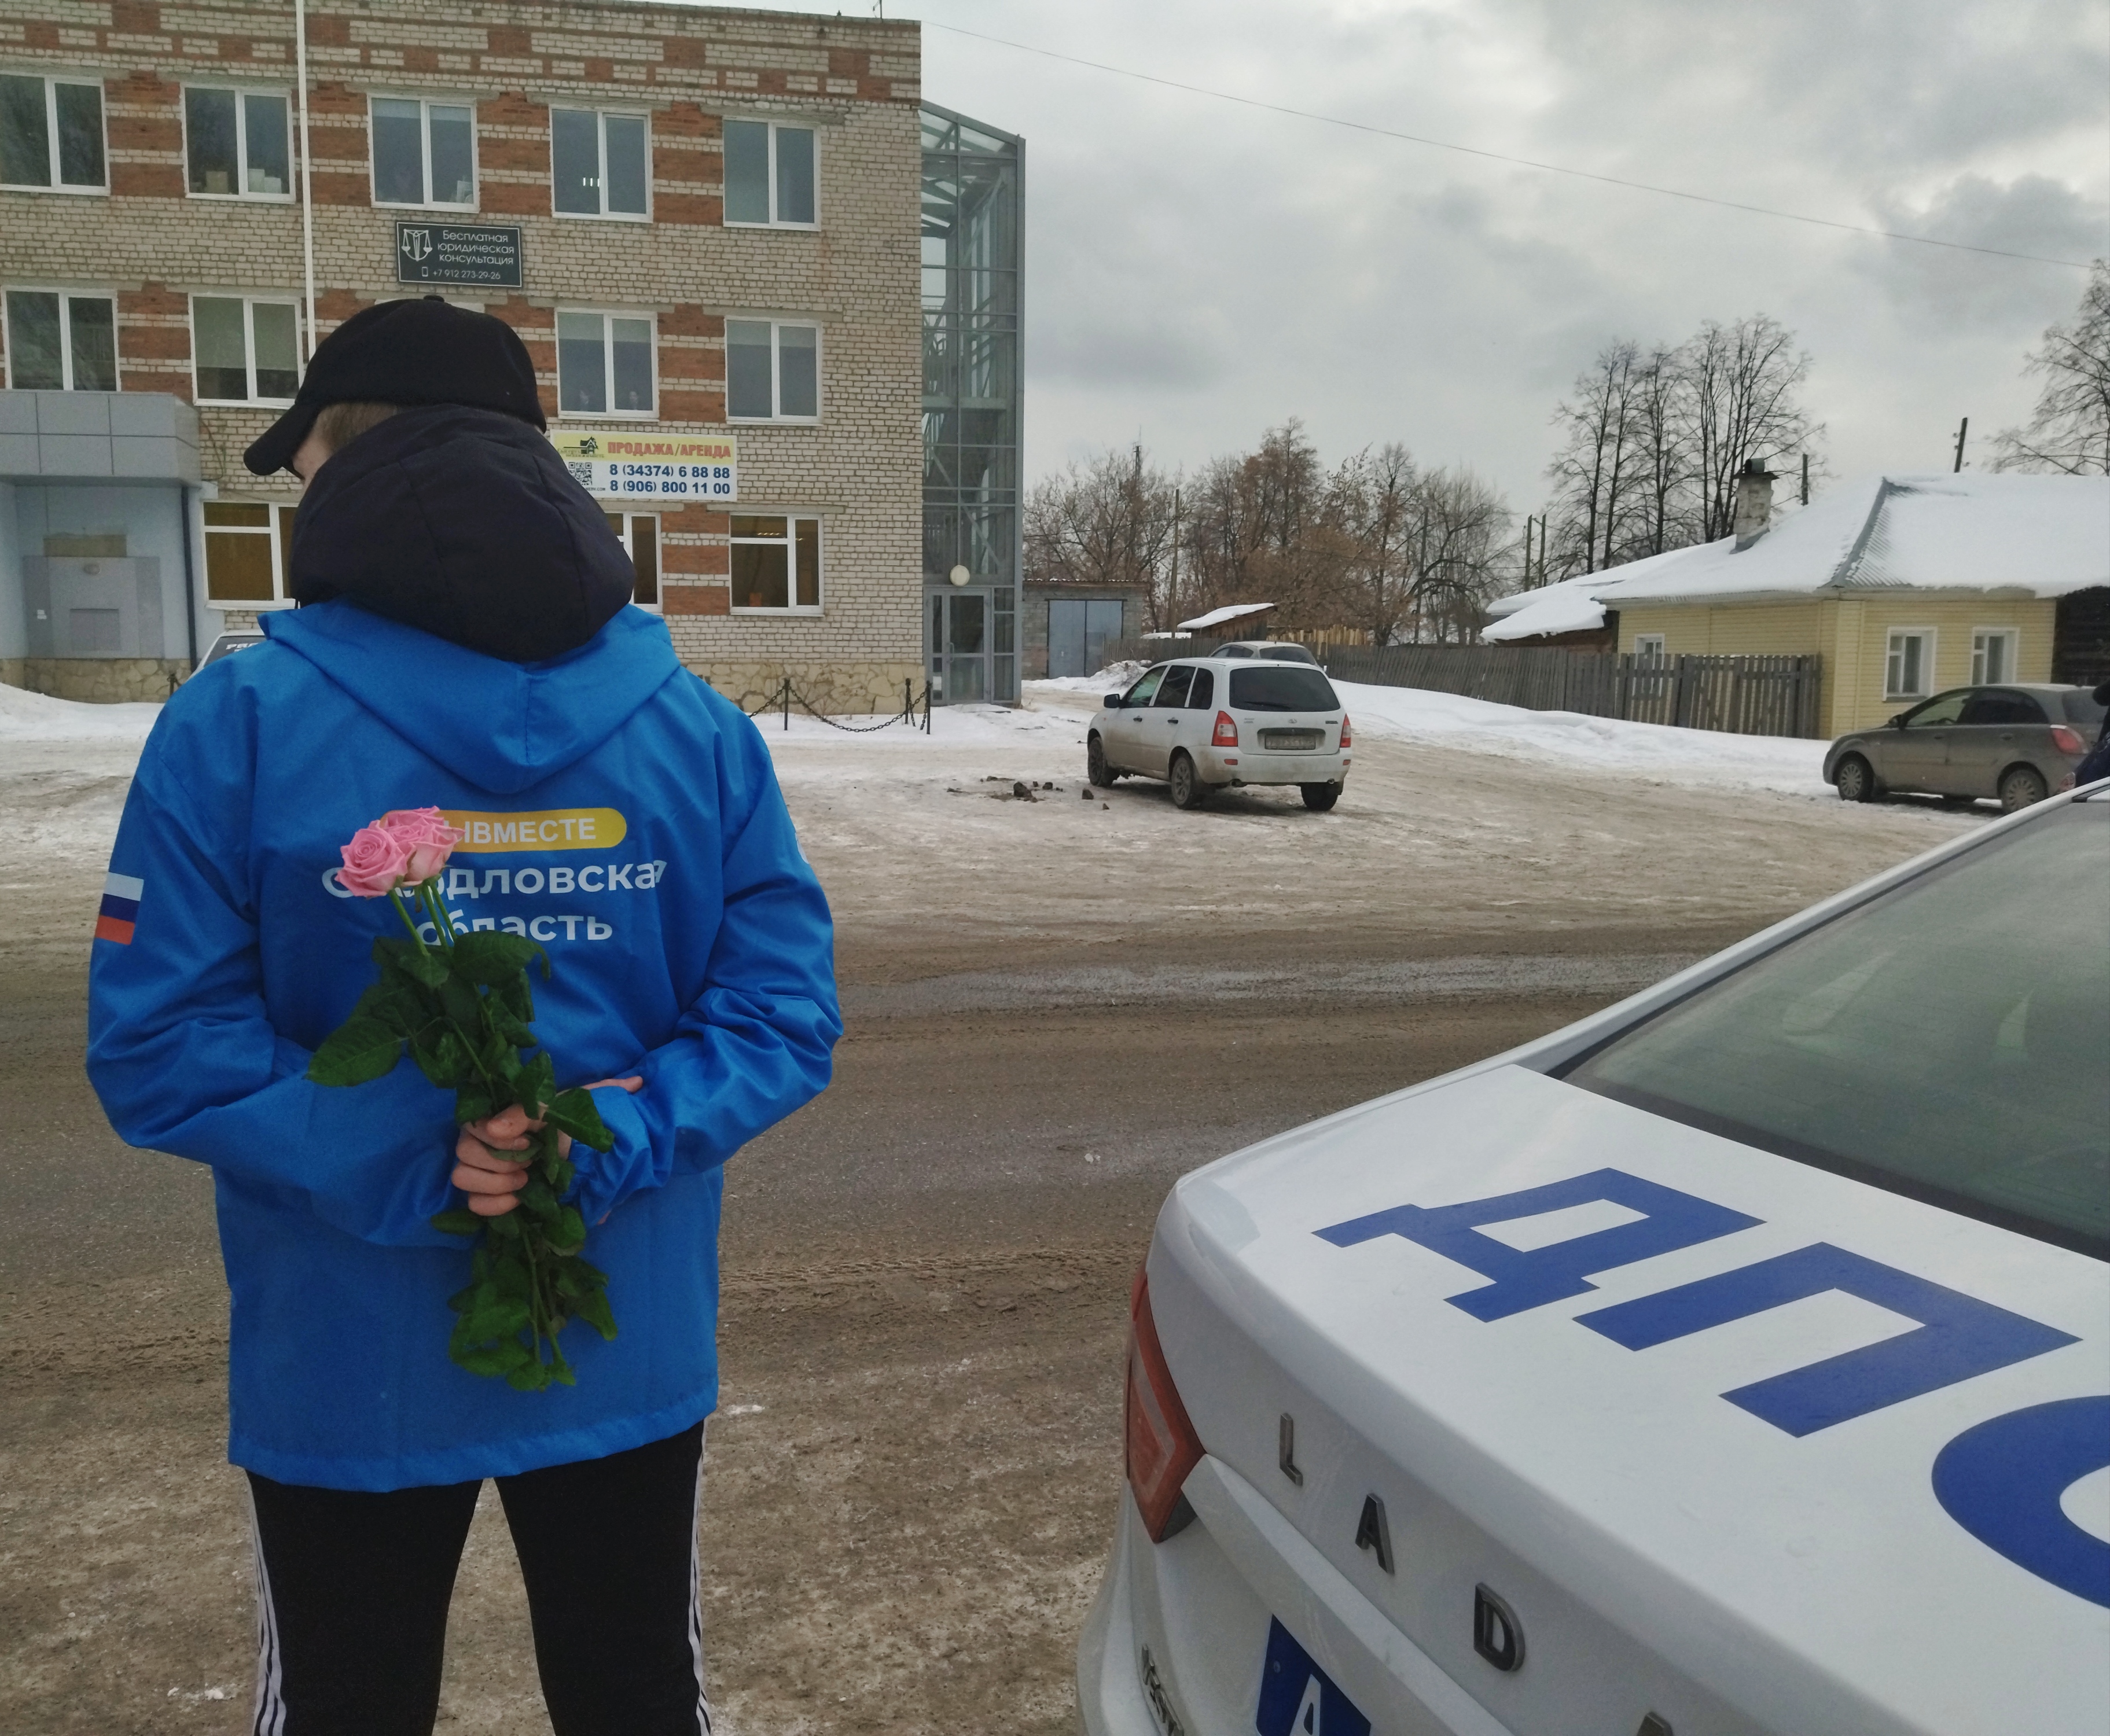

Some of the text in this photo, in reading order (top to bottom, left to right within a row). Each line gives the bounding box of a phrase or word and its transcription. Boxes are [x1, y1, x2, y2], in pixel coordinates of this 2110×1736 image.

[443, 230, 508, 242] Бесплатная
[438, 243, 514, 254] юридическая
[439, 254, 513, 265] консультация
[444, 270, 459, 278] 912
[461, 270, 501, 279] 273-29-26
[608, 442, 731, 459] ПРОДАЖА/АРЕНДА
[609, 464, 730, 479] 8 (34374) 6 88 88
[610, 480, 730, 494] 8 (906) 800 11 00
[1280, 1413, 1673, 1736] LAD
